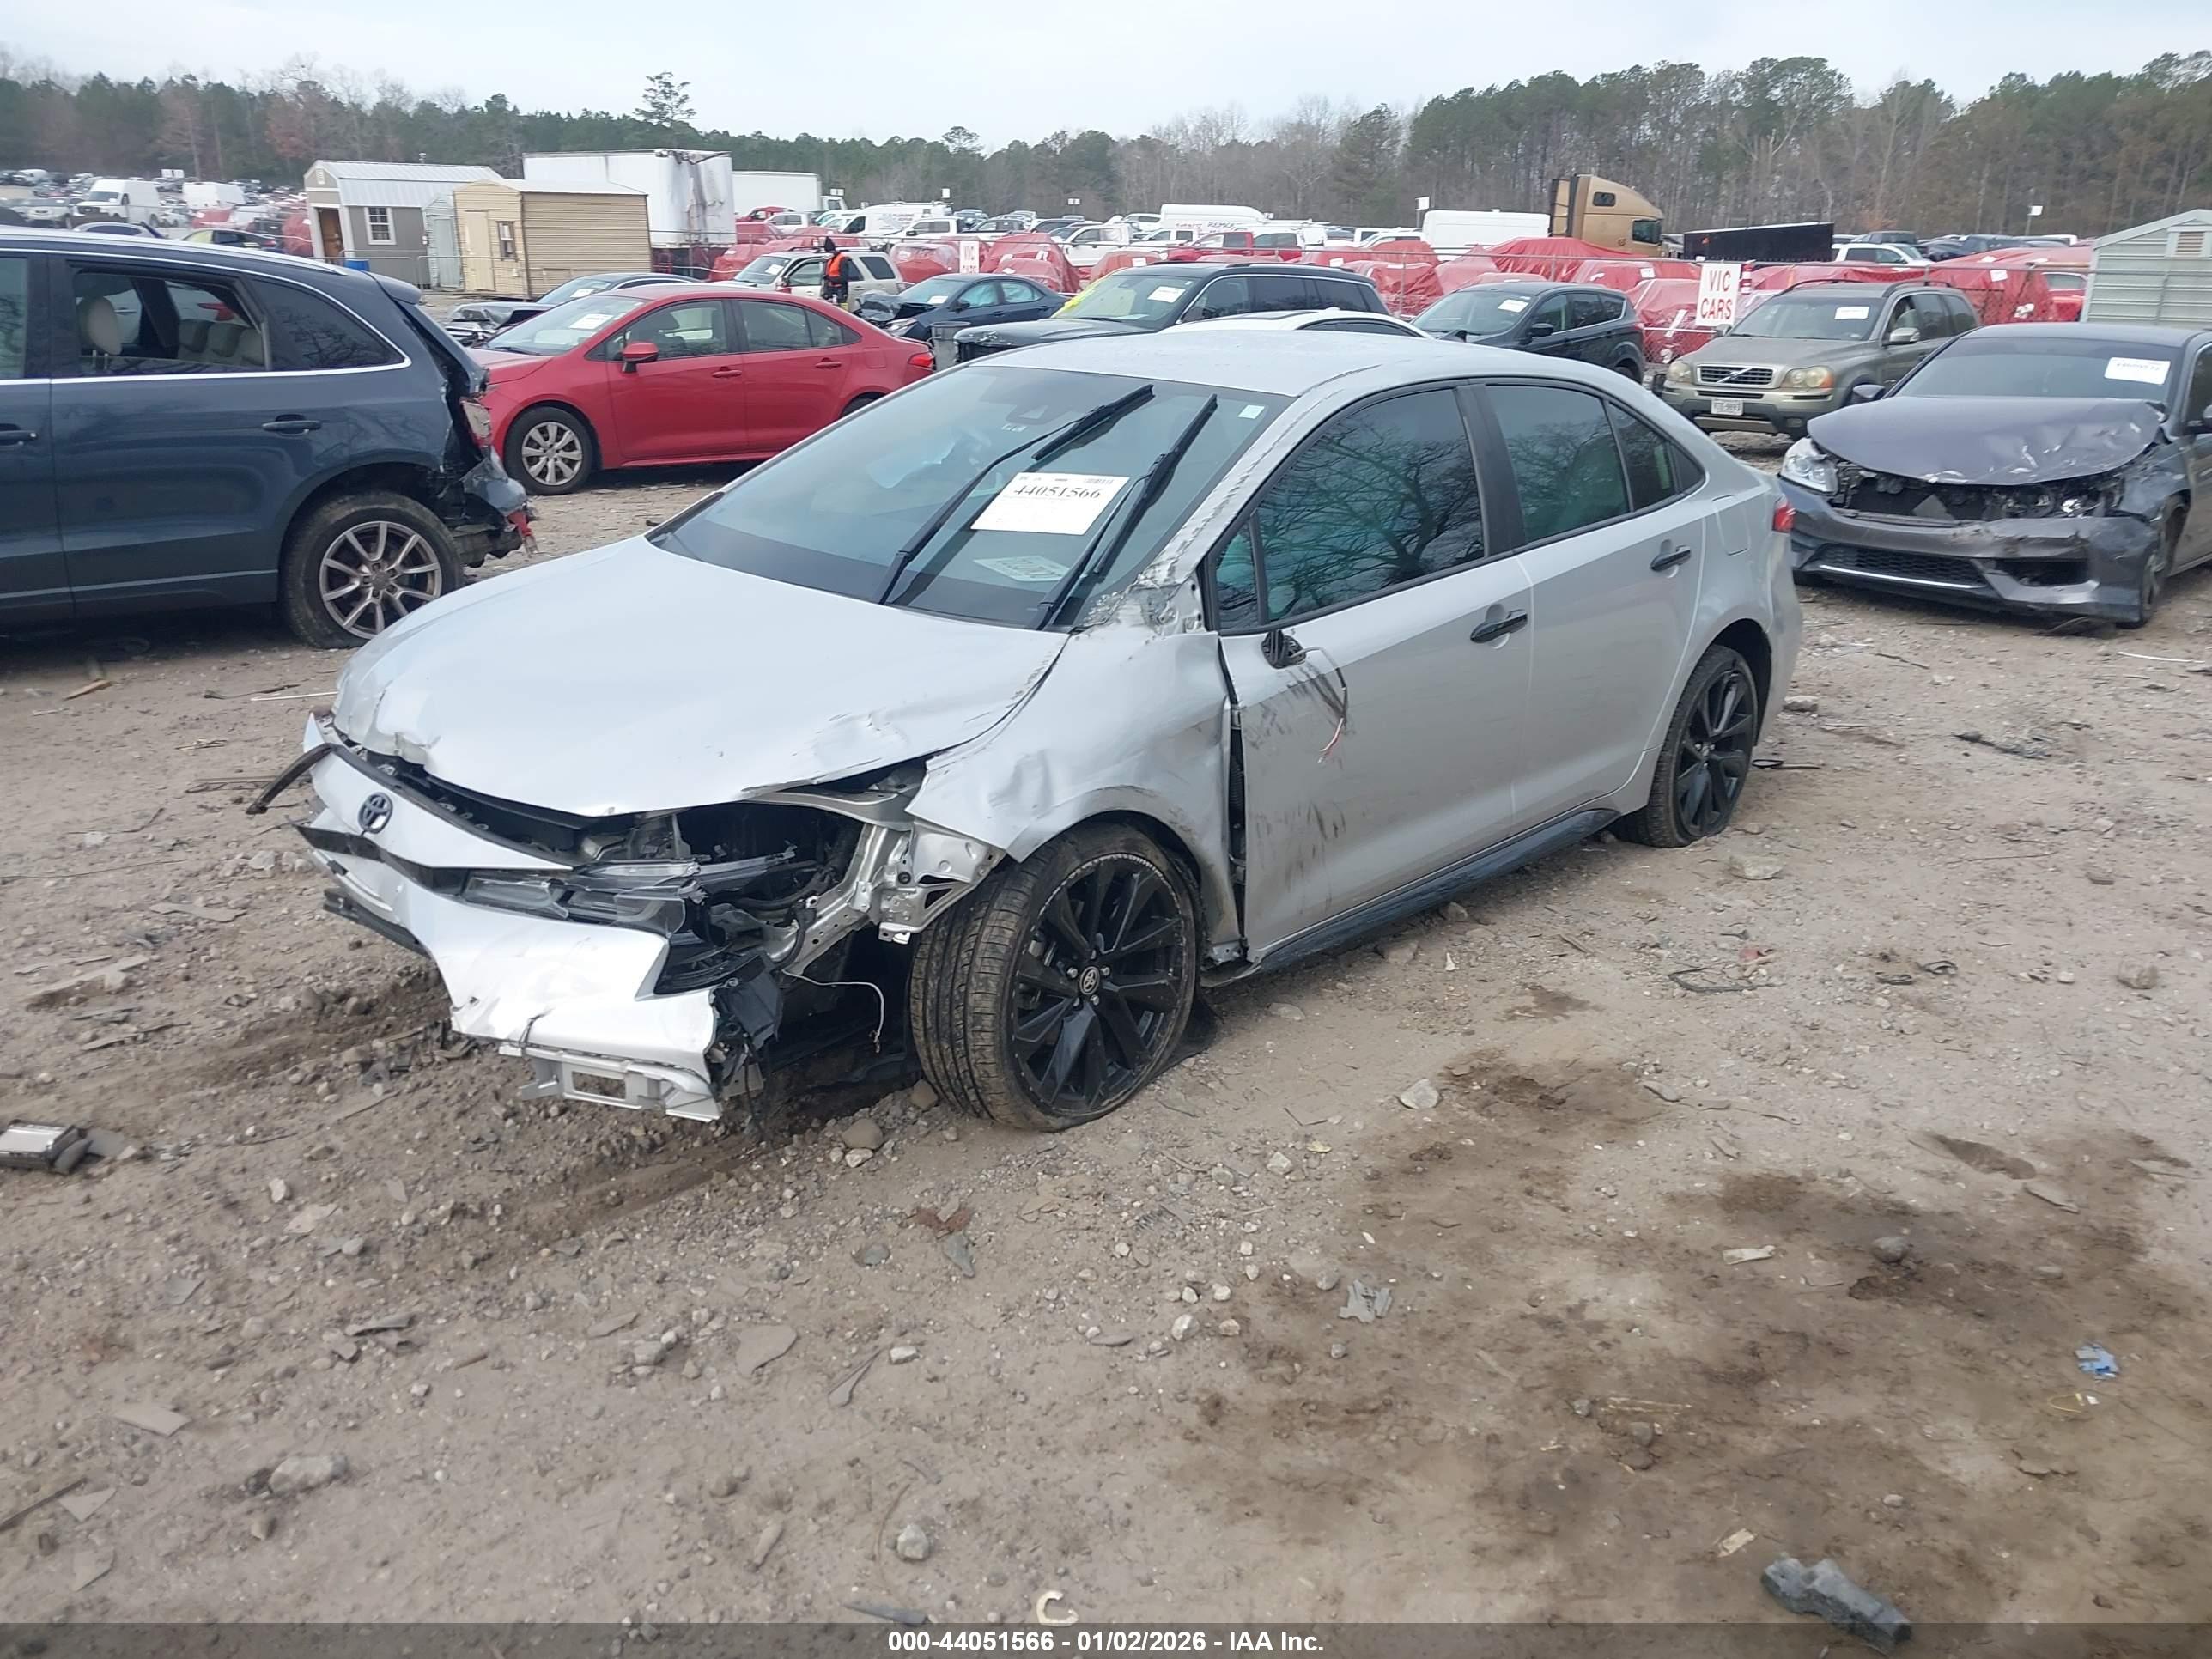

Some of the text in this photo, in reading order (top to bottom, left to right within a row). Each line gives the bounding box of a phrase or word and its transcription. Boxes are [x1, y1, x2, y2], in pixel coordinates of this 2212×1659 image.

[1709, 270, 1731, 291] VIC
[1700, 298, 1733, 319] CARS
[1013, 484, 1103, 499] 44051566
